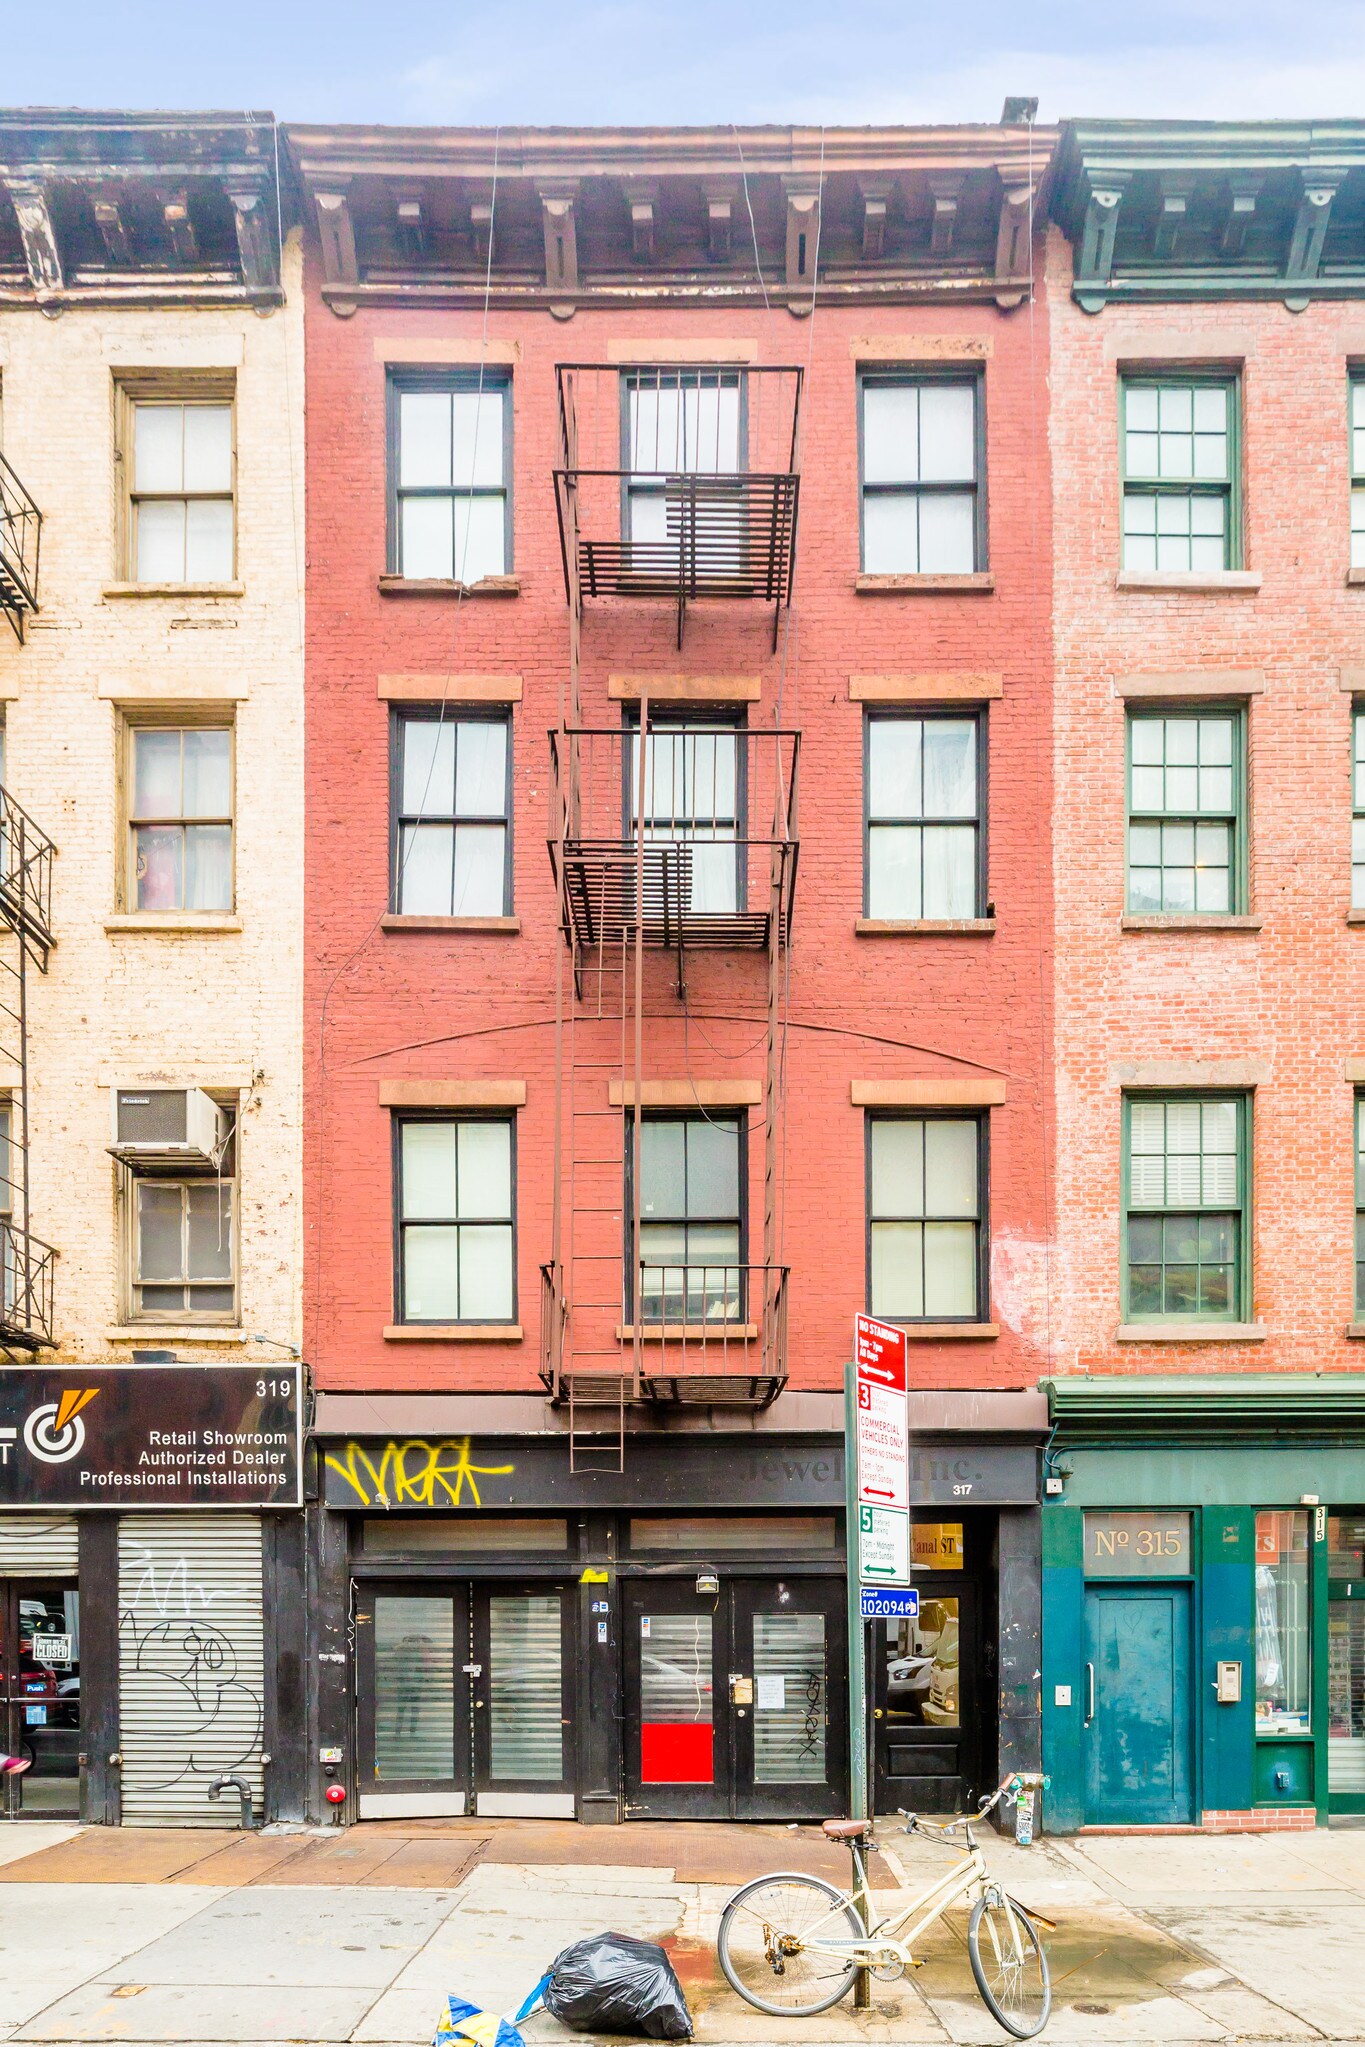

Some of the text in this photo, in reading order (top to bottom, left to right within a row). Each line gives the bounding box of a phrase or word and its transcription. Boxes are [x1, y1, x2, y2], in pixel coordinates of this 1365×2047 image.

[858, 1319, 900, 1345] NO STANDING
[256, 1380, 291, 1397] 319
[860, 1384, 870, 1408] 3
[860, 1415, 900, 1436] COMMERCIAL
[150, 1431, 287, 1445] Retail Showroom
[861, 1429, 904, 1449] VEHICLES ONLY
[138, 1451, 286, 1466] Authorized Dealer
[885, 1451, 905, 1463] STANDING
[80, 1471, 287, 1486] Professional Installations
[953, 1484, 973, 1495] 317
[862, 1508, 871, 1530] 5
[1316, 1507, 1325, 1540] 315
[940, 1537, 955, 1554] ST
[1136, 1530, 1181, 1556] 315
[862, 1599, 904, 1614] 102094
[37, 1645, 67, 1658] CLOSED
